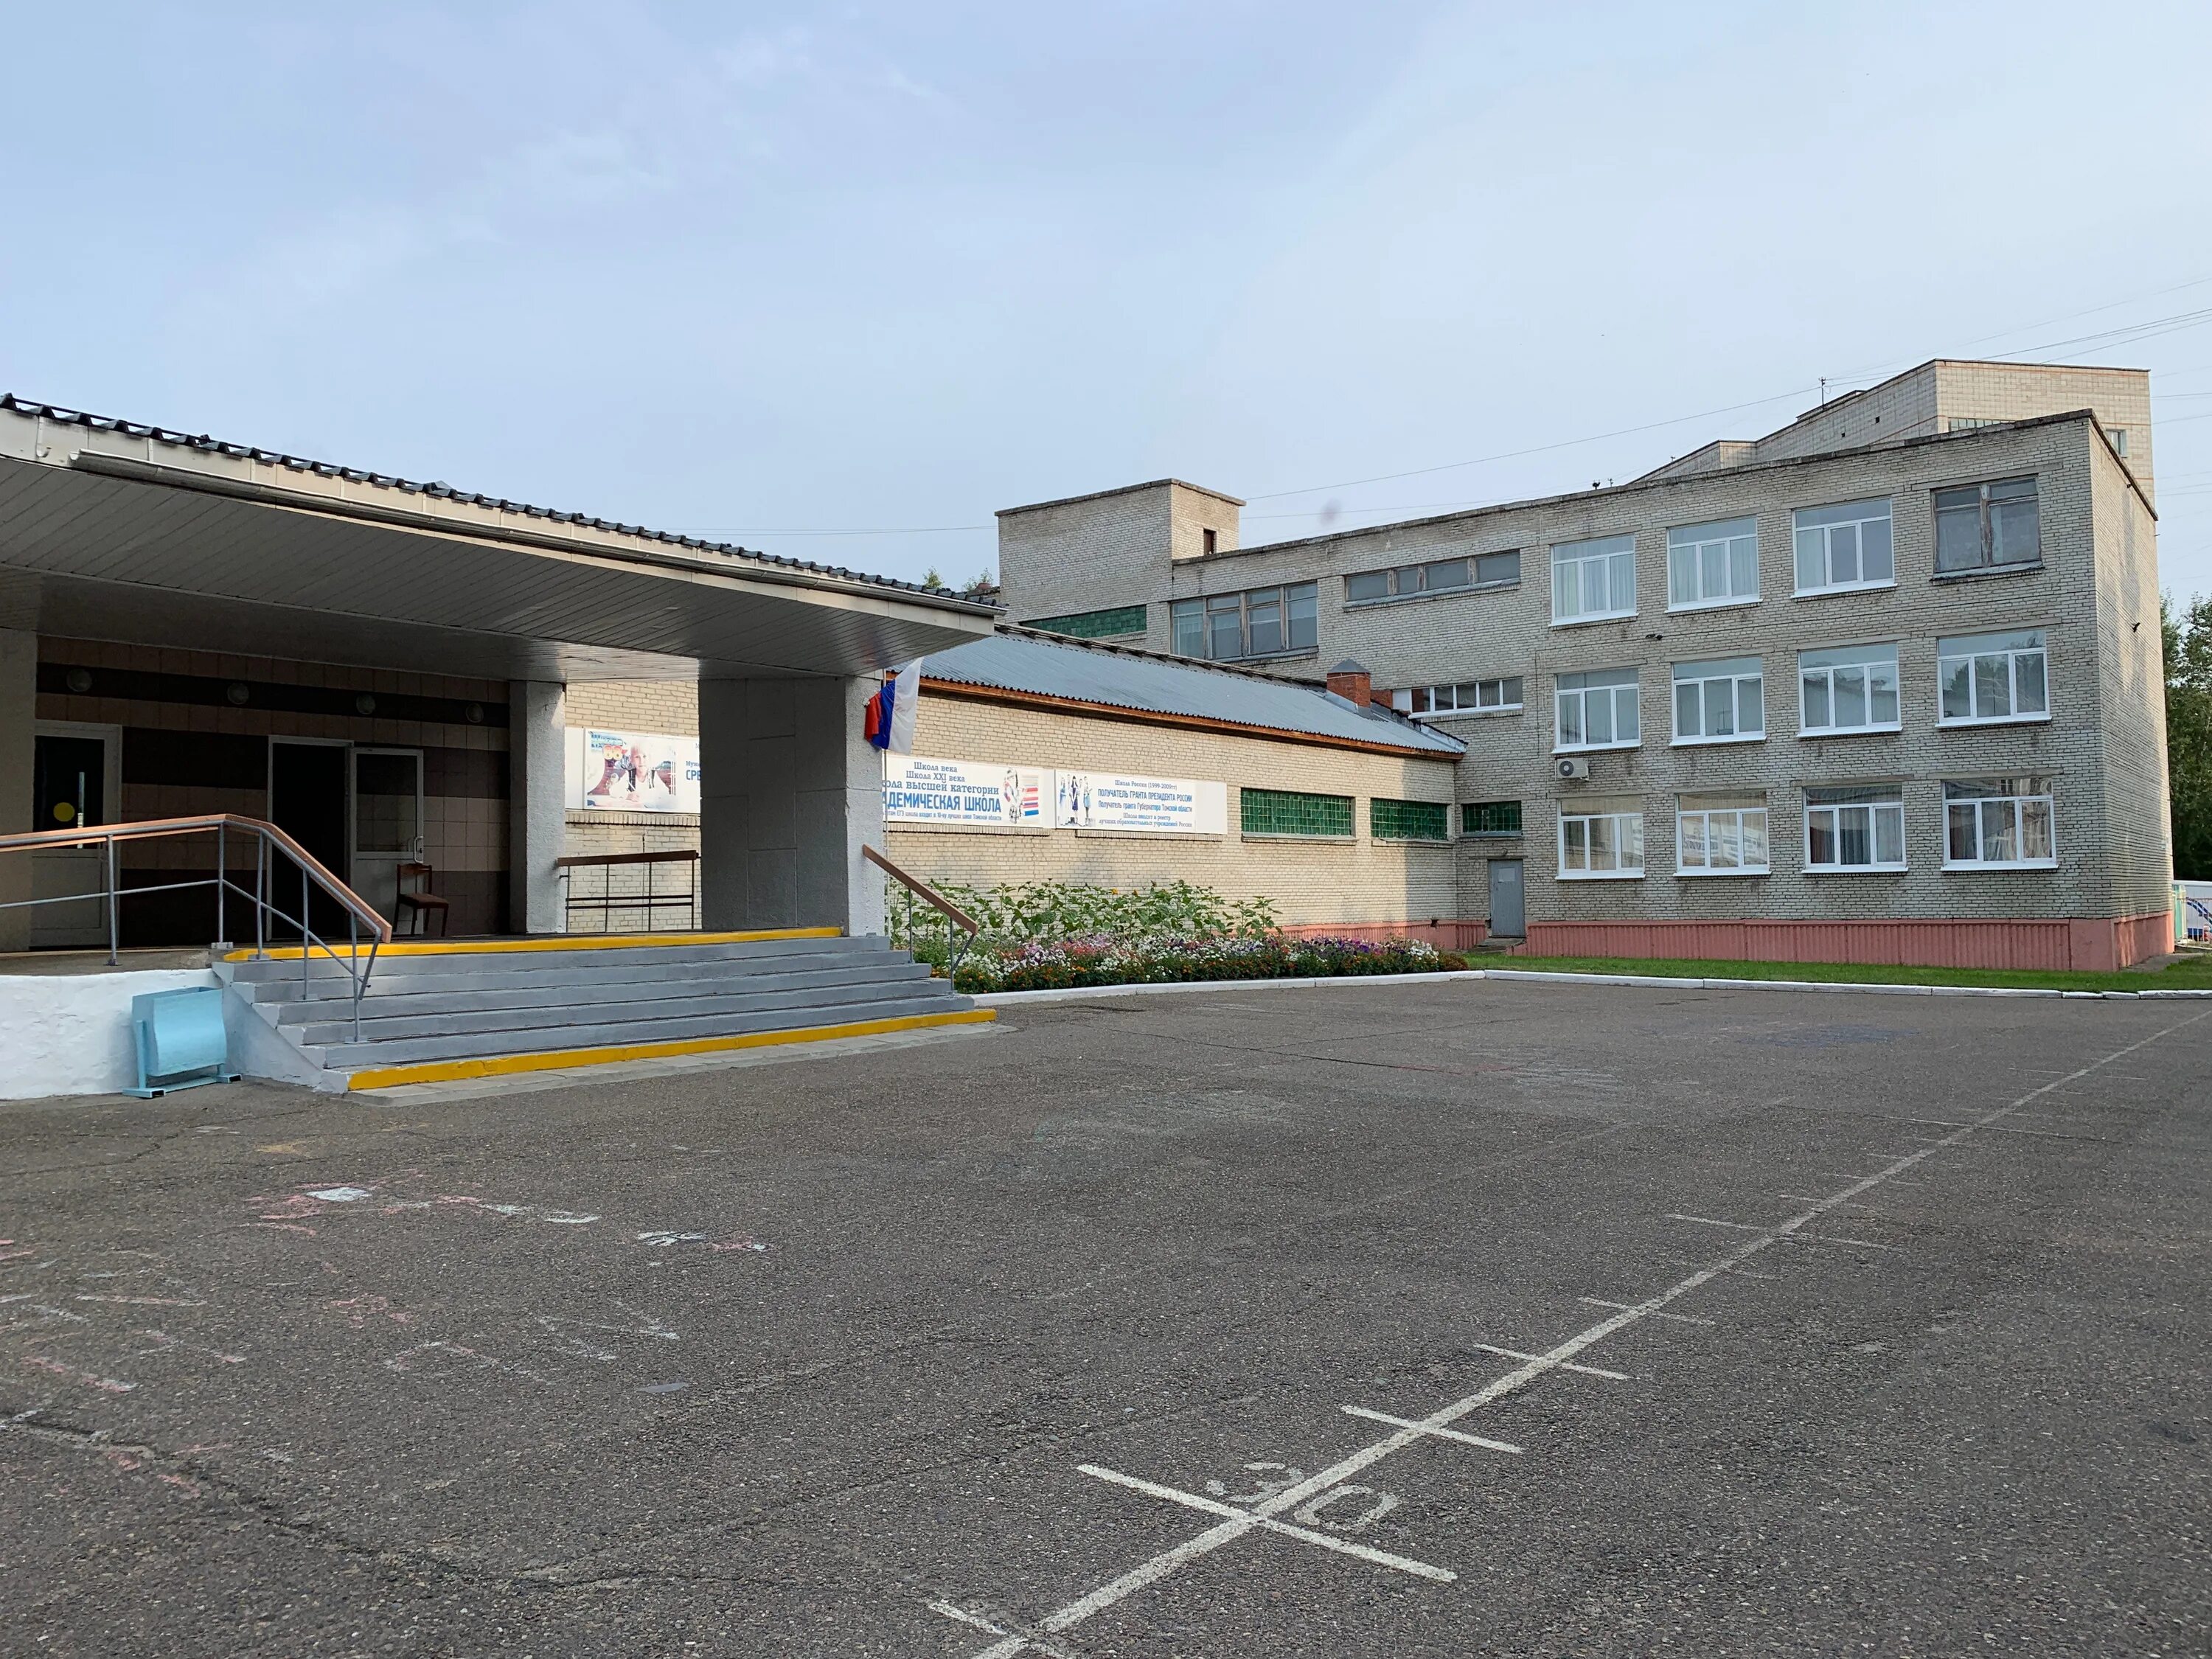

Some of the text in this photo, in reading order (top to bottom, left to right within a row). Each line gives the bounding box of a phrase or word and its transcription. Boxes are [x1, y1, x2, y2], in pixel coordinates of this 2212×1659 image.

[914, 762, 939, 771] Школа
[905, 771, 931, 779] Школа
[933, 773, 947, 781] XXI
[905, 780, 947, 791] высшей
[950, 784, 999, 796] категории
[1098, 788, 1192, 802] ПОЛУЧАТЕЛЬ ГРАНТА ПРЕЗИДЕНТА РОССИИ
[964, 796, 1001, 813] ШКОЛА
[1098, 800, 1122, 809] Получатель
[1137, 802, 1161, 812] Губернатора
[1161, 804, 1178, 812] Томской
